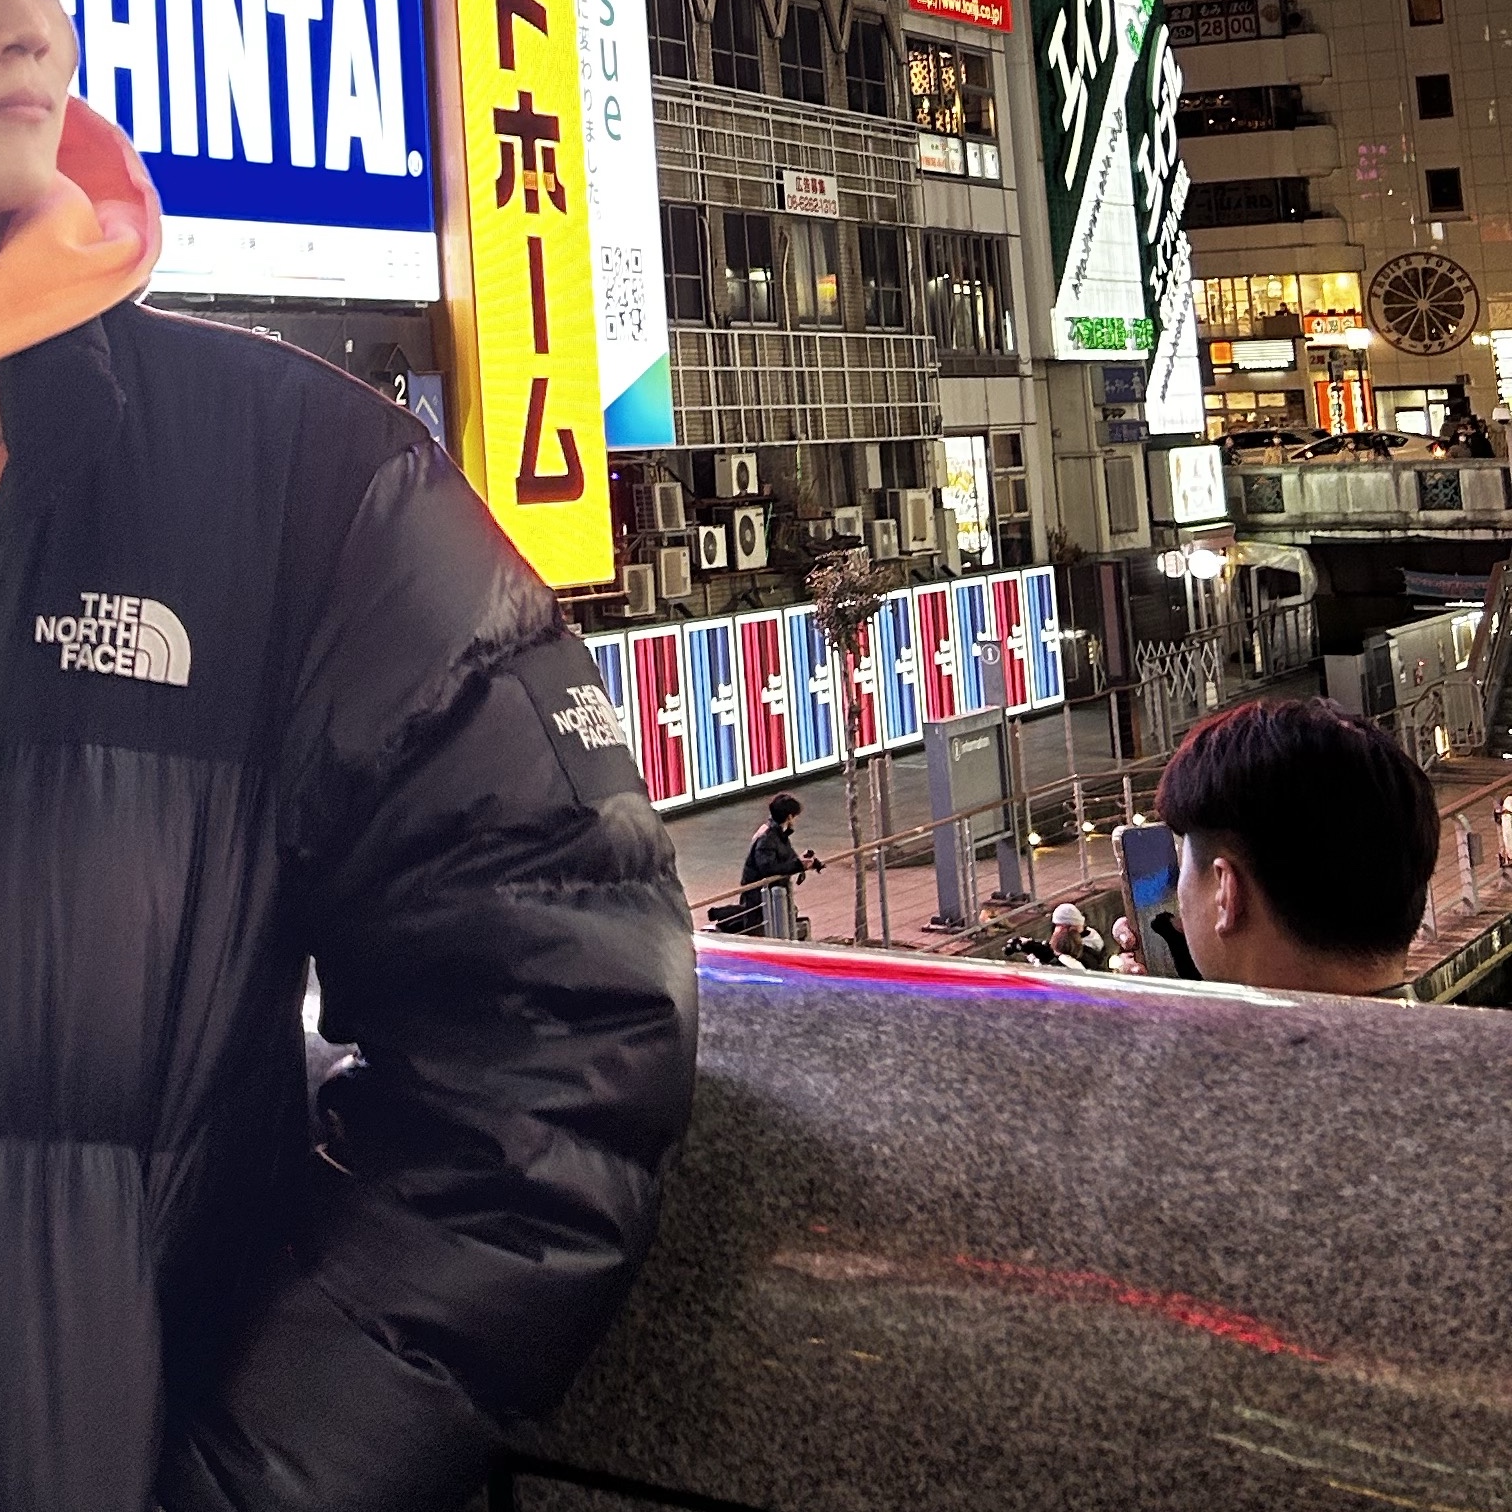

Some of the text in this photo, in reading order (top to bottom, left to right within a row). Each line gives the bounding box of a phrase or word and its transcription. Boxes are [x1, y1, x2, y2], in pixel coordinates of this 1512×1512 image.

[1371, 253, 1474, 299] FRUITS TOWER
[80, 592, 141, 624] THE
[34, 614, 139, 649] NORTH
[59, 643, 135, 677] FACE
[567, 685, 600, 707] THE
[552, 705, 609, 735] NORTH
